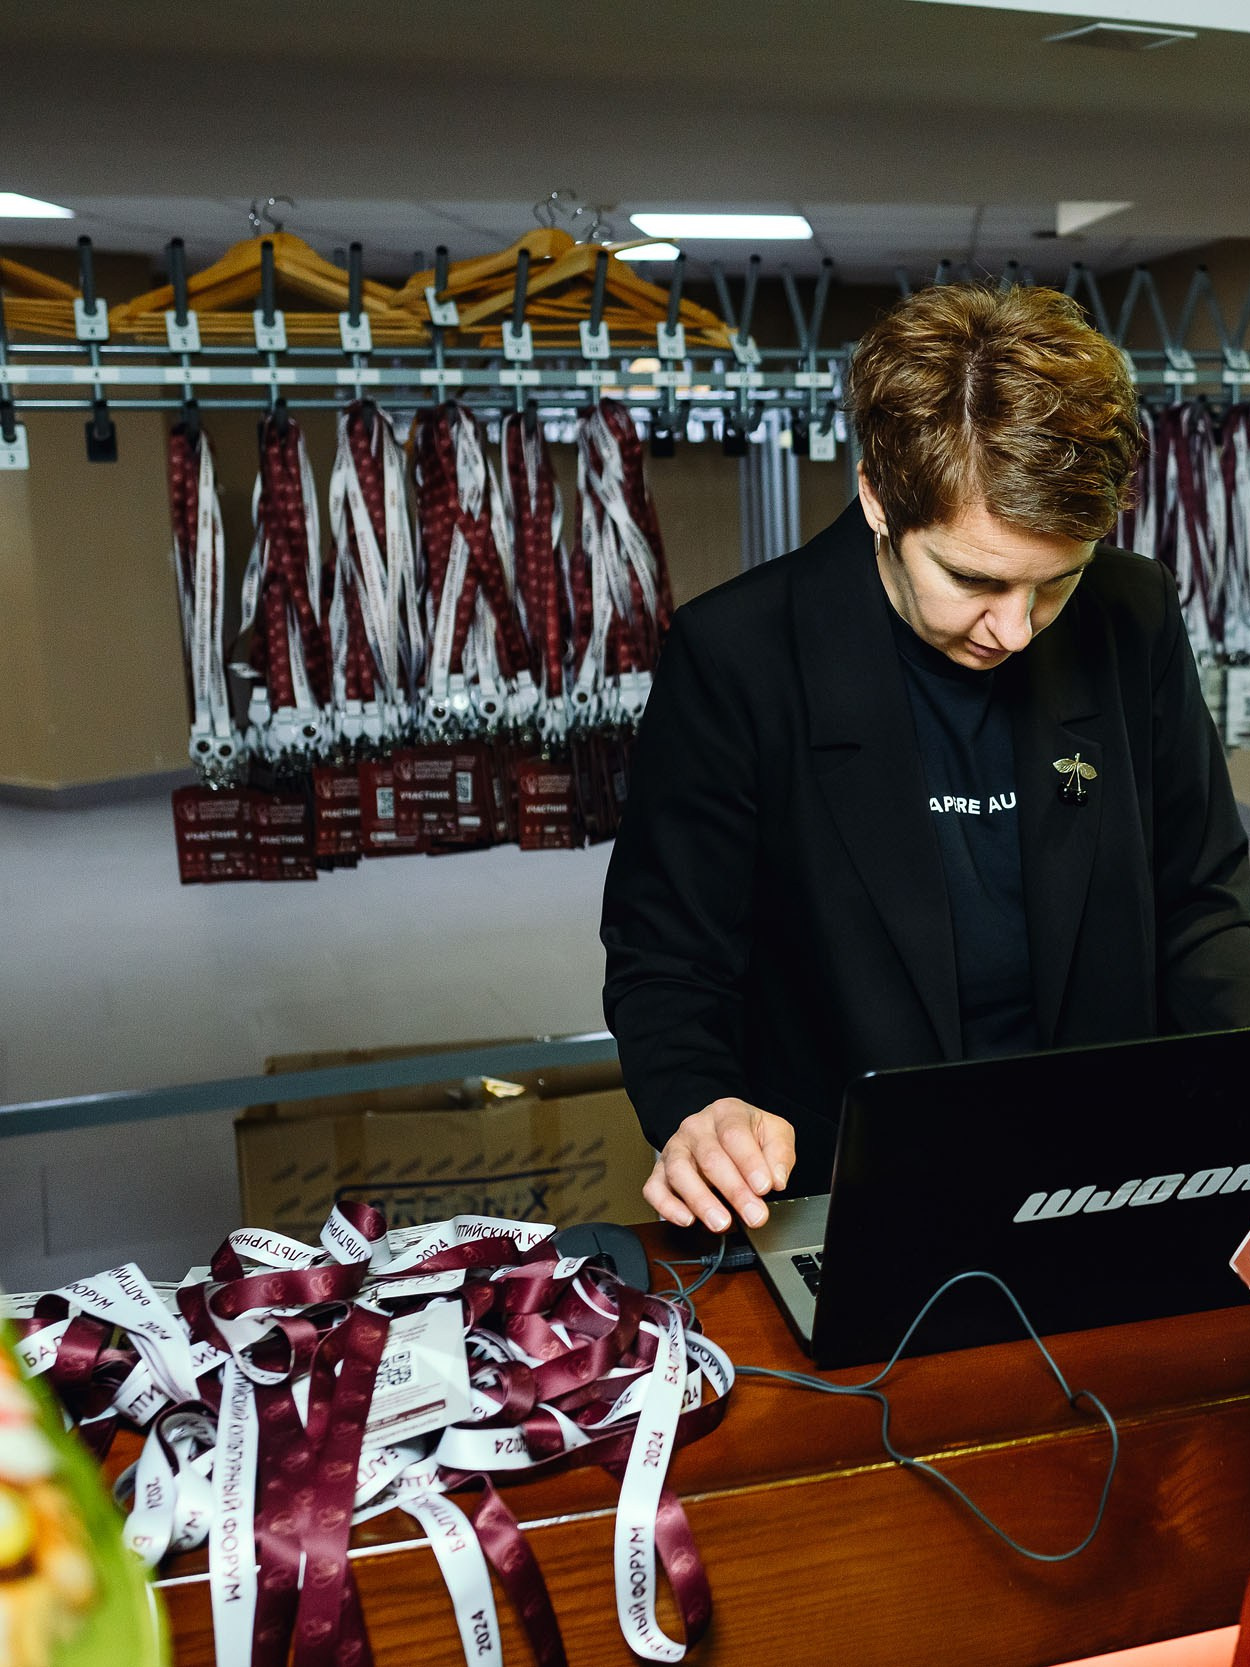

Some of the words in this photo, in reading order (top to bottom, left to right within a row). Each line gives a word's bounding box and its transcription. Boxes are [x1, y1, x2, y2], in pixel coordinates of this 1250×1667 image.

[989, 792, 1017, 814] AU
[642, 1430, 666, 1468] 2024
[221, 1517, 242, 1604] ФОРУМ
[470, 1609, 492, 1657] 2024
